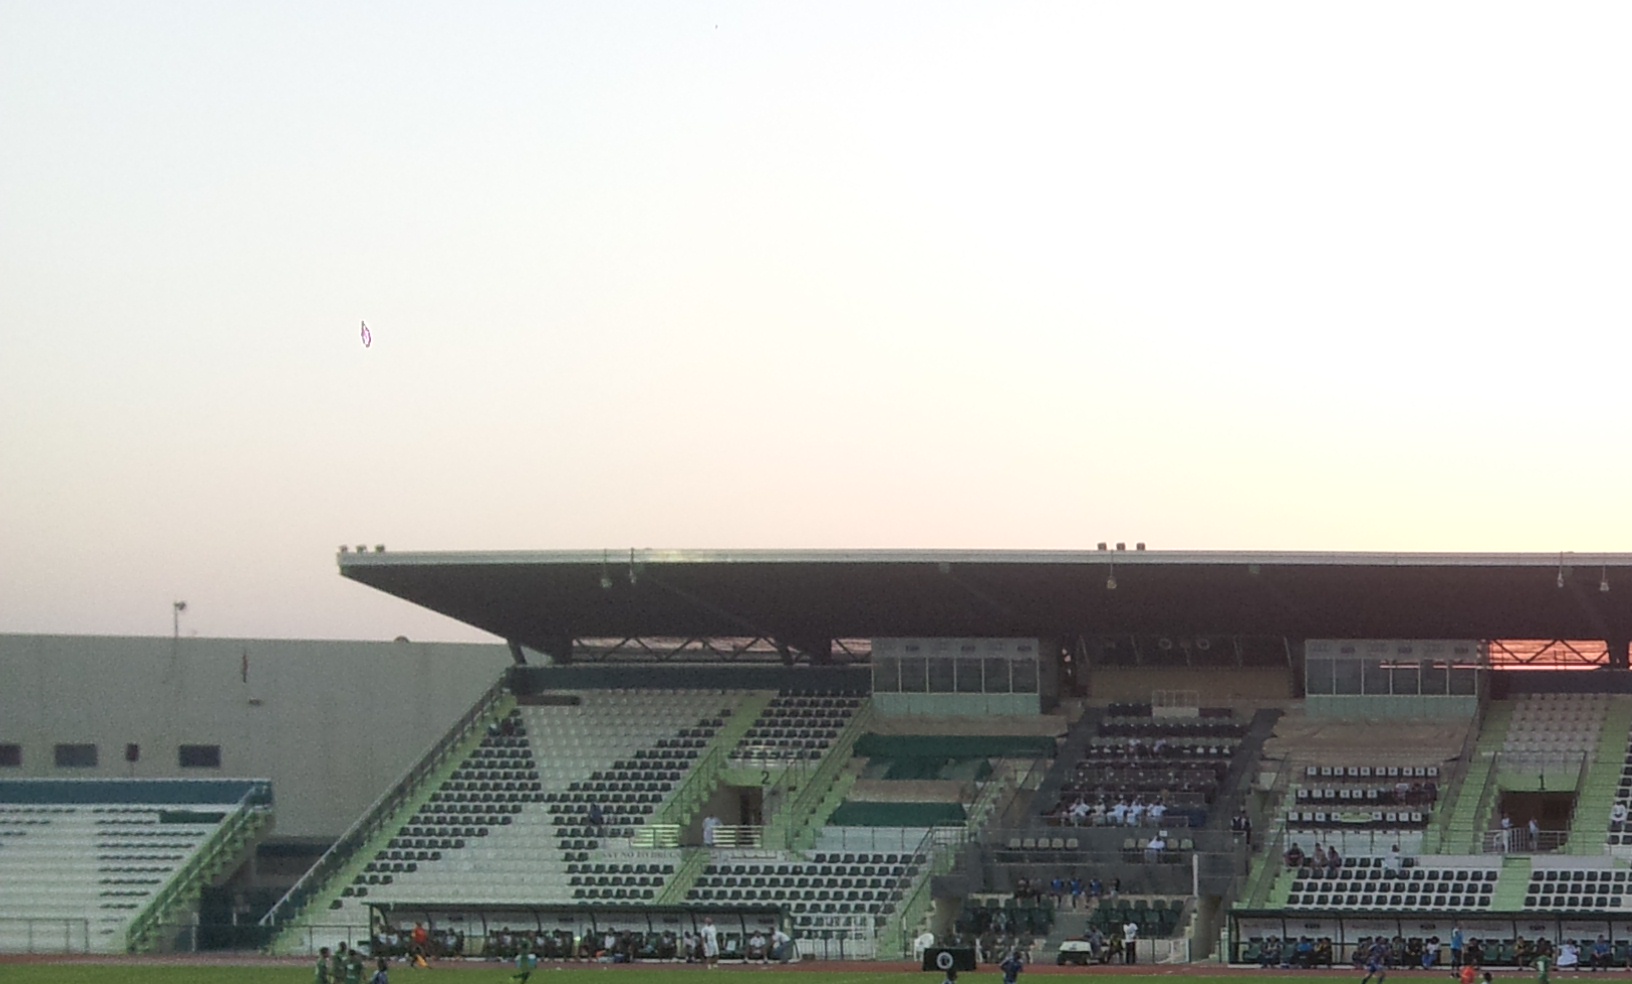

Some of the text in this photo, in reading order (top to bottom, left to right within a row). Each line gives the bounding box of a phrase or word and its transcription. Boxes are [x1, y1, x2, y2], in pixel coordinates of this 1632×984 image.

[761, 770, 770, 785] 2
[1538, 774, 1546, 790] 1
[622, 850, 635, 858] NO
